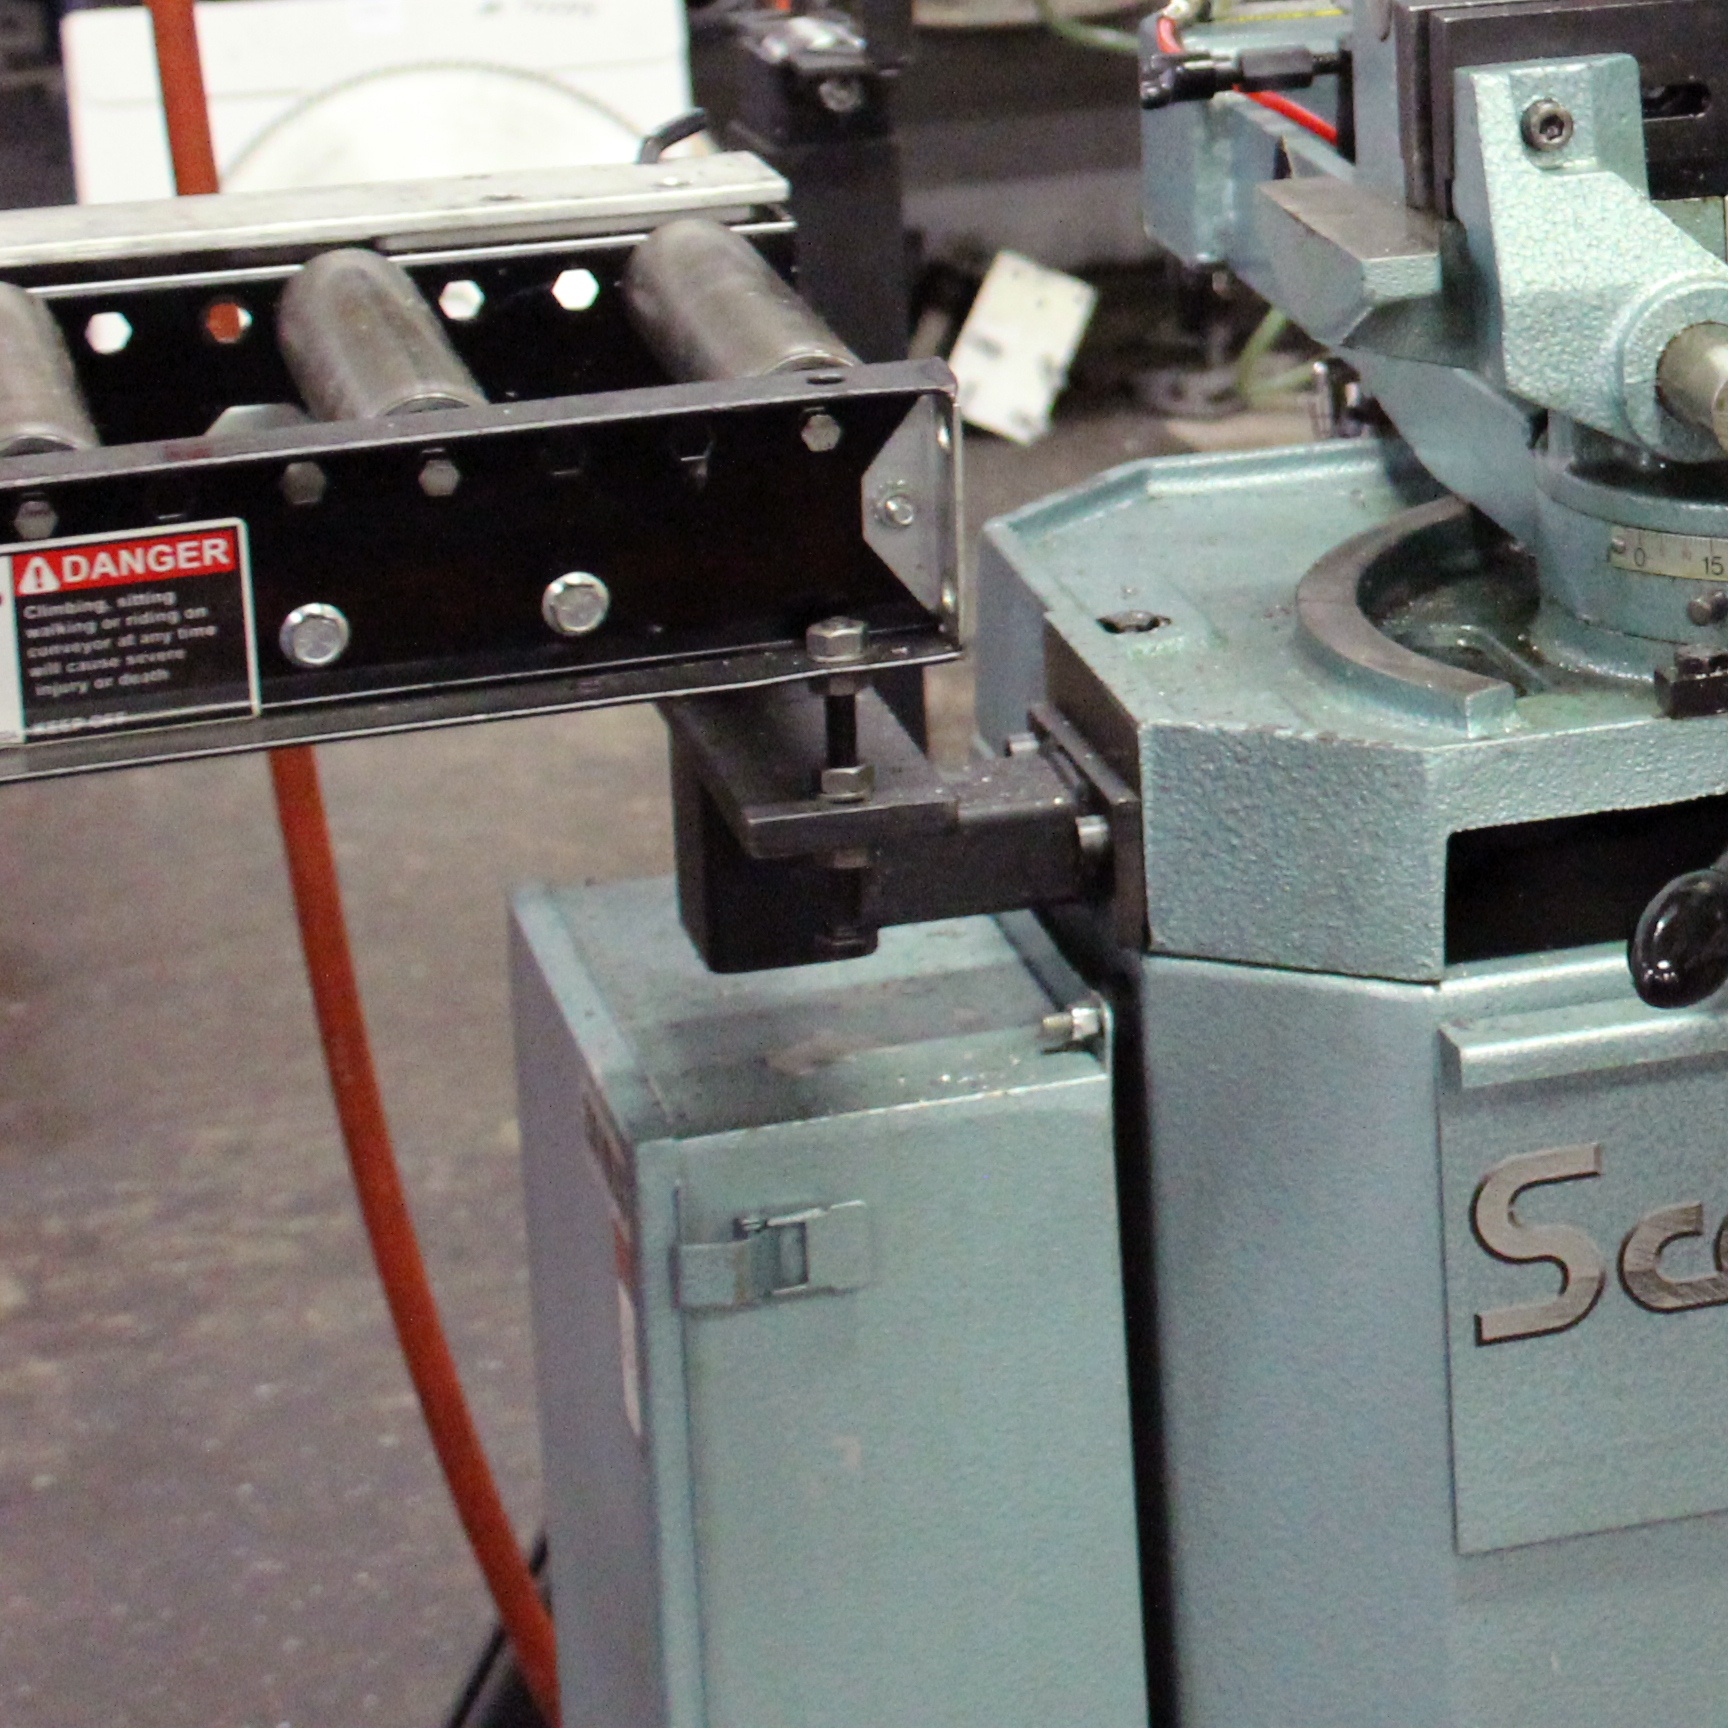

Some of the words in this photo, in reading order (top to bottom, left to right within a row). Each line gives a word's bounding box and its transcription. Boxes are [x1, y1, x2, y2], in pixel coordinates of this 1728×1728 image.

[61, 537, 231, 583] DANGER
[1633, 547, 1646, 567] 0
[1702, 556, 1725, 576] 15
[25, 621, 97, 639] walking
[101, 617, 121, 630] or
[125, 610, 181, 626] riding
[183, 607, 209, 619] on
[26, 638, 113, 659] conveyor
[117, 634, 137, 647] at
[177, 625, 218, 640] time
[65, 657, 121, 673] cause
[125, 649, 187, 666] severe
[94, 677, 115, 689] or
